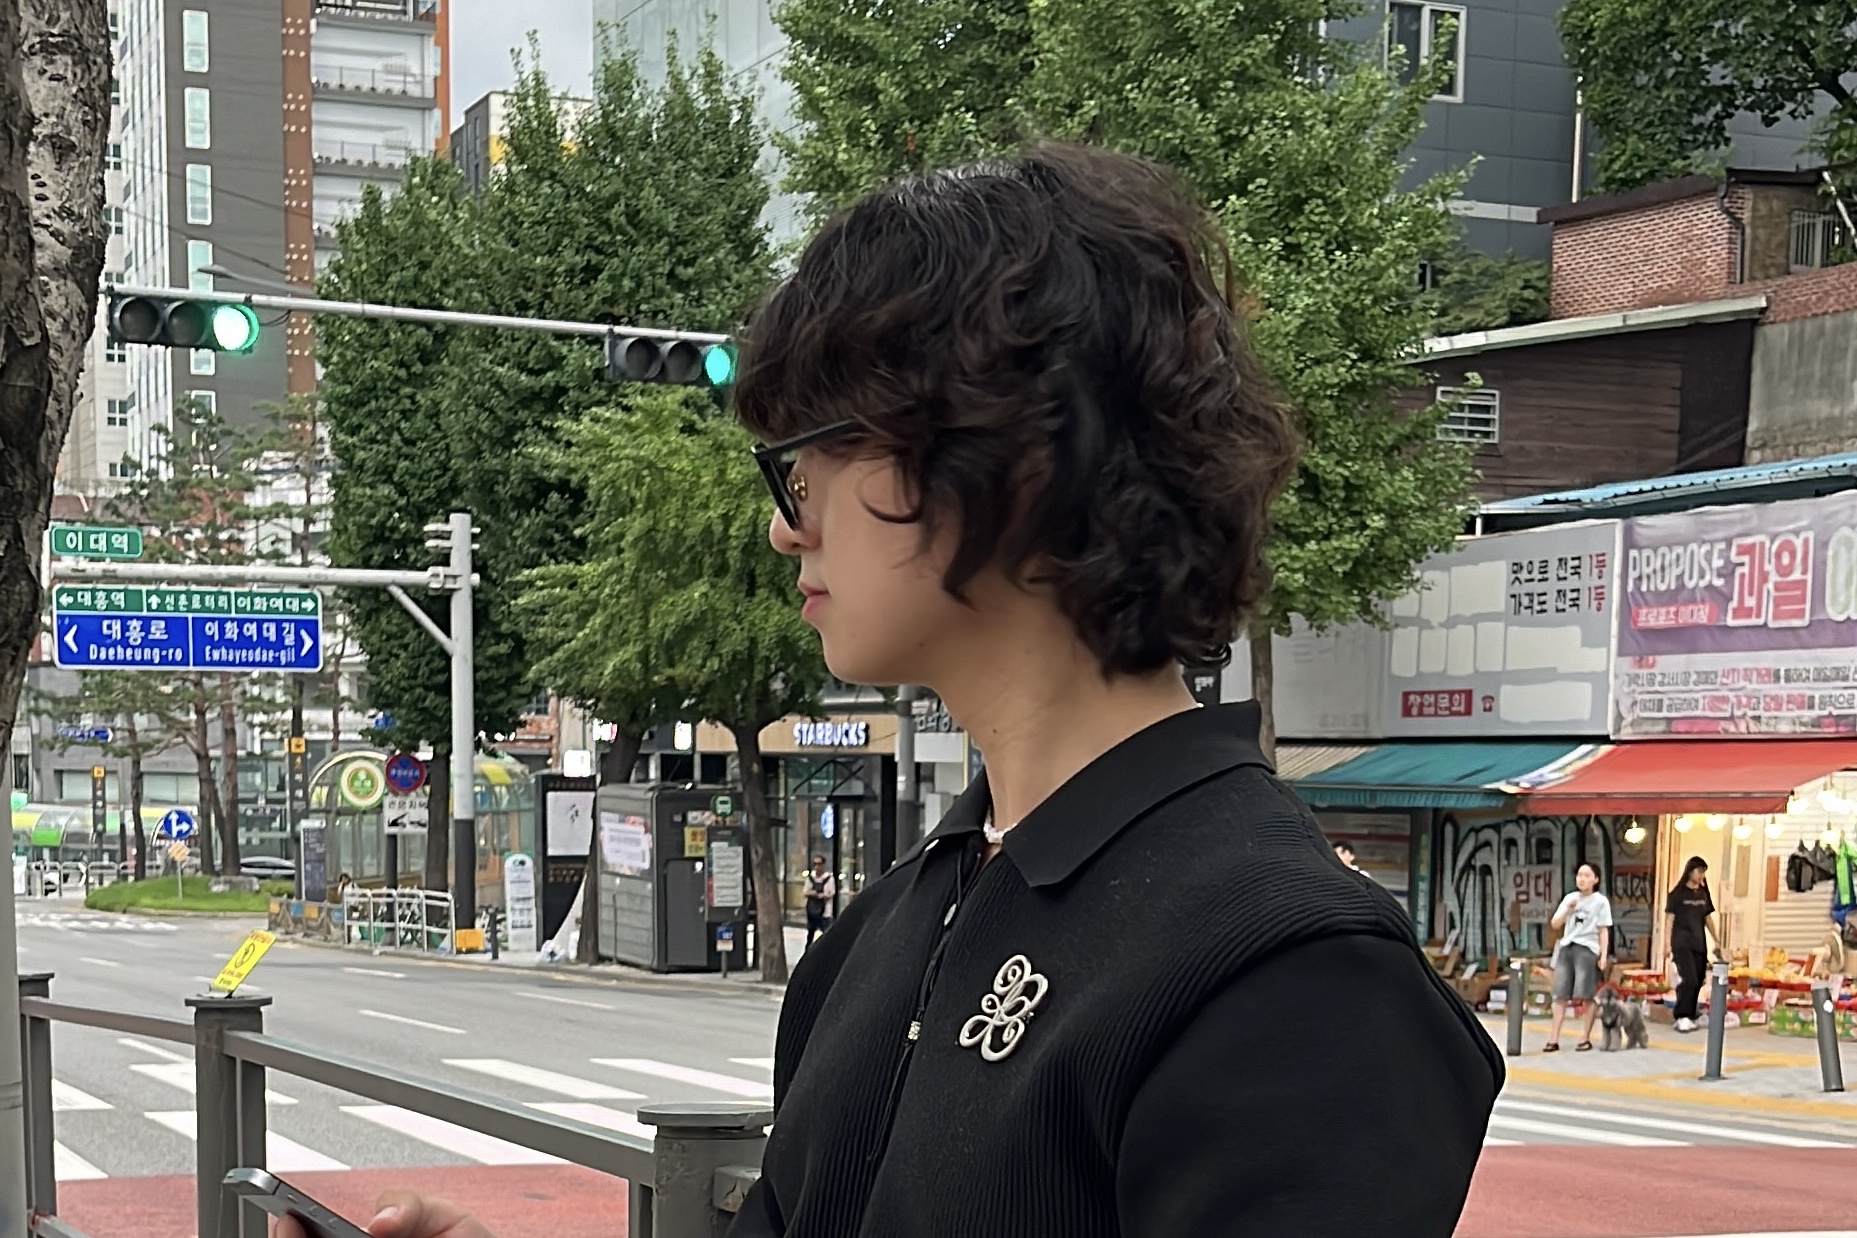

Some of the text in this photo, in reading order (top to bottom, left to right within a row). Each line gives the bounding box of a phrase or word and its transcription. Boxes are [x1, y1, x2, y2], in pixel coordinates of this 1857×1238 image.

[66, 532, 129, 553] 이대역
[1511, 552, 1607, 586] 맛으로 전국 1등
[1627, 541, 1726, 593] PROPOSE
[1728, 531, 1813, 627] 과일
[236, 596, 300, 613] 이화여대
[1509, 584, 1606, 616] 가격도 전국 1등
[102, 618, 169, 646] 대흥로
[204, 621, 296, 646] 이화여대길
[89, 645, 183, 661] Daeheung-ro
[204, 645, 296, 665] Ewhayeodae-gil
[1408, 693, 1466, 716] 창업문의
[793, 721, 868, 746] STARBUCKS
[1513, 870, 1553, 904] 임대
